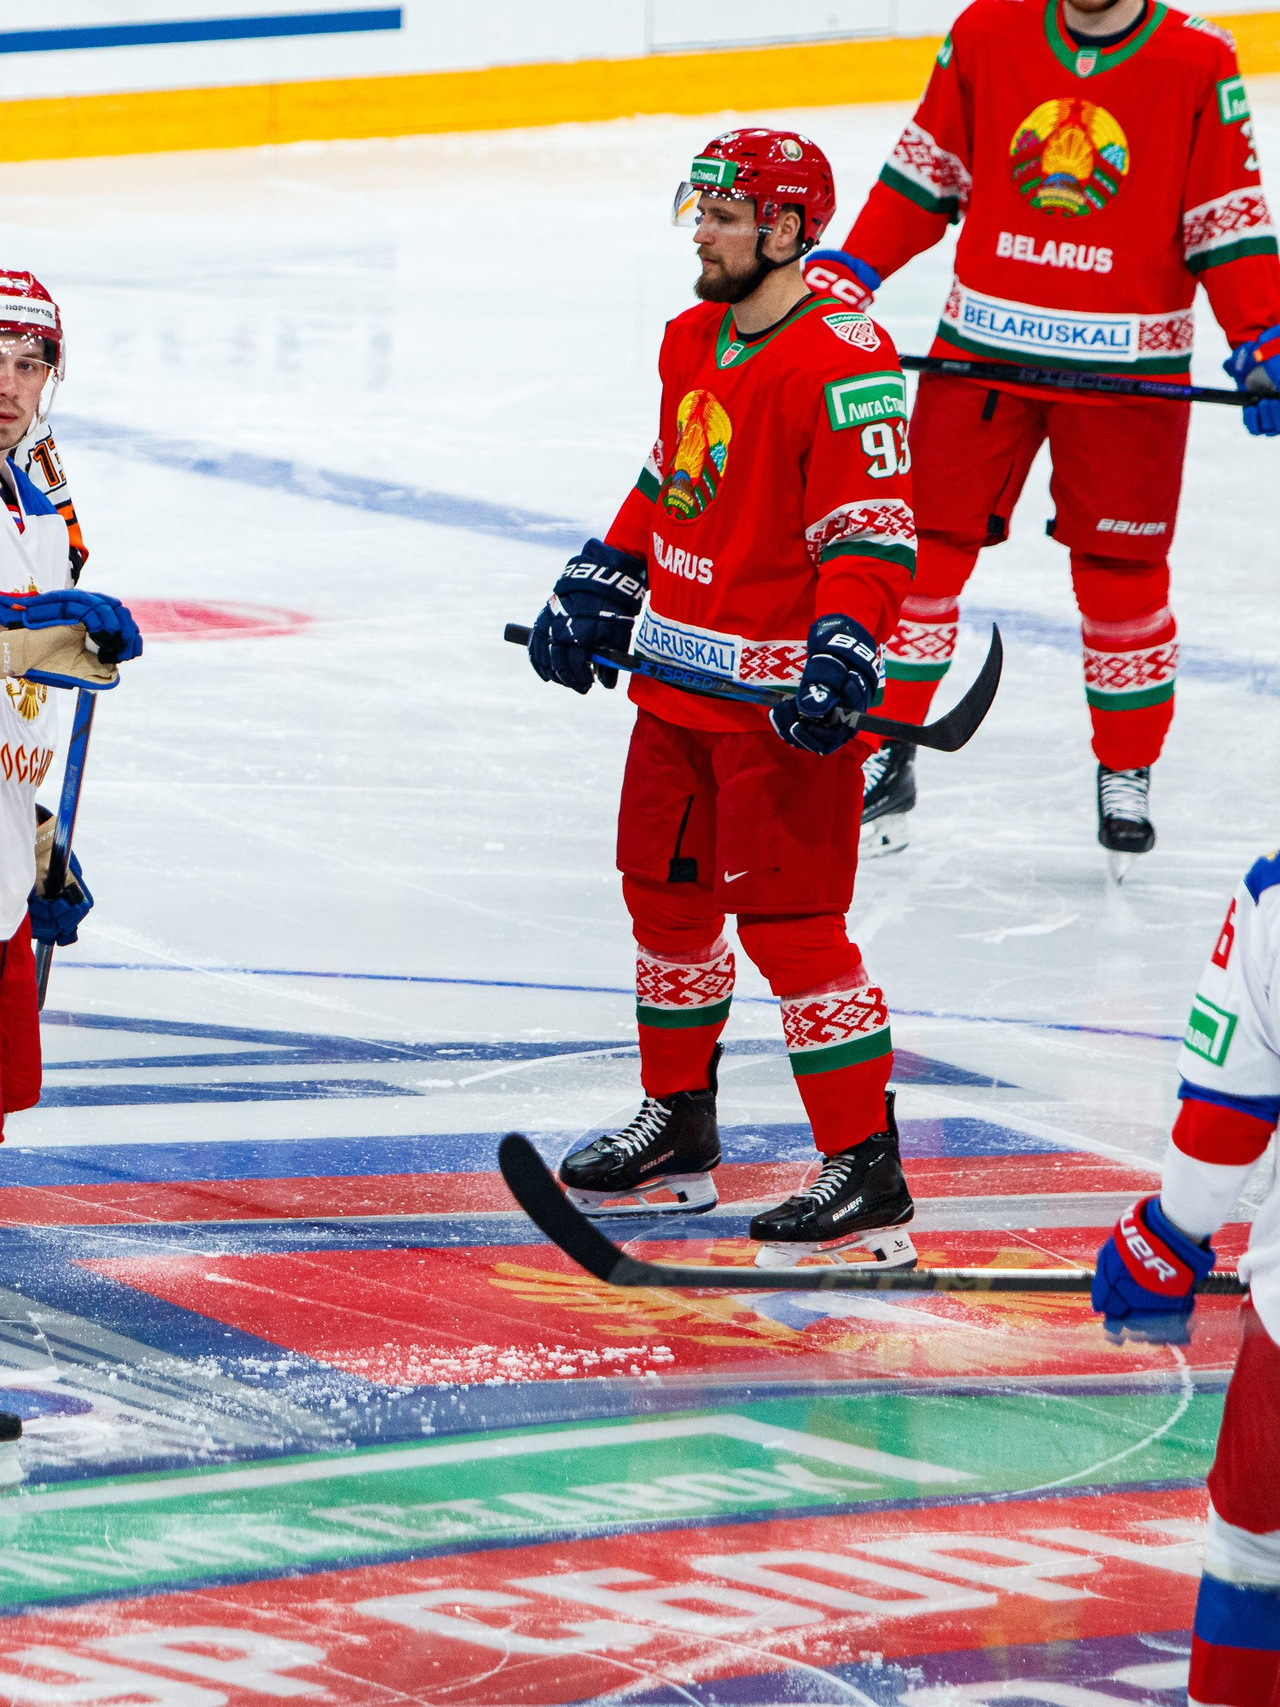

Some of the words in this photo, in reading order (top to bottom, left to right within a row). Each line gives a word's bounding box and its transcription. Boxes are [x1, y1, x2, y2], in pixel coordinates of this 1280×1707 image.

[776, 184, 809, 194] CCM
[996, 231, 1114, 274] BELARUS
[963, 303, 1131, 347] BELARUSKALI
[1096, 518, 1167, 536] BAUER
[633, 660, 714, 690] JETSPEED
[832, 1195, 863, 1222] BAUER
